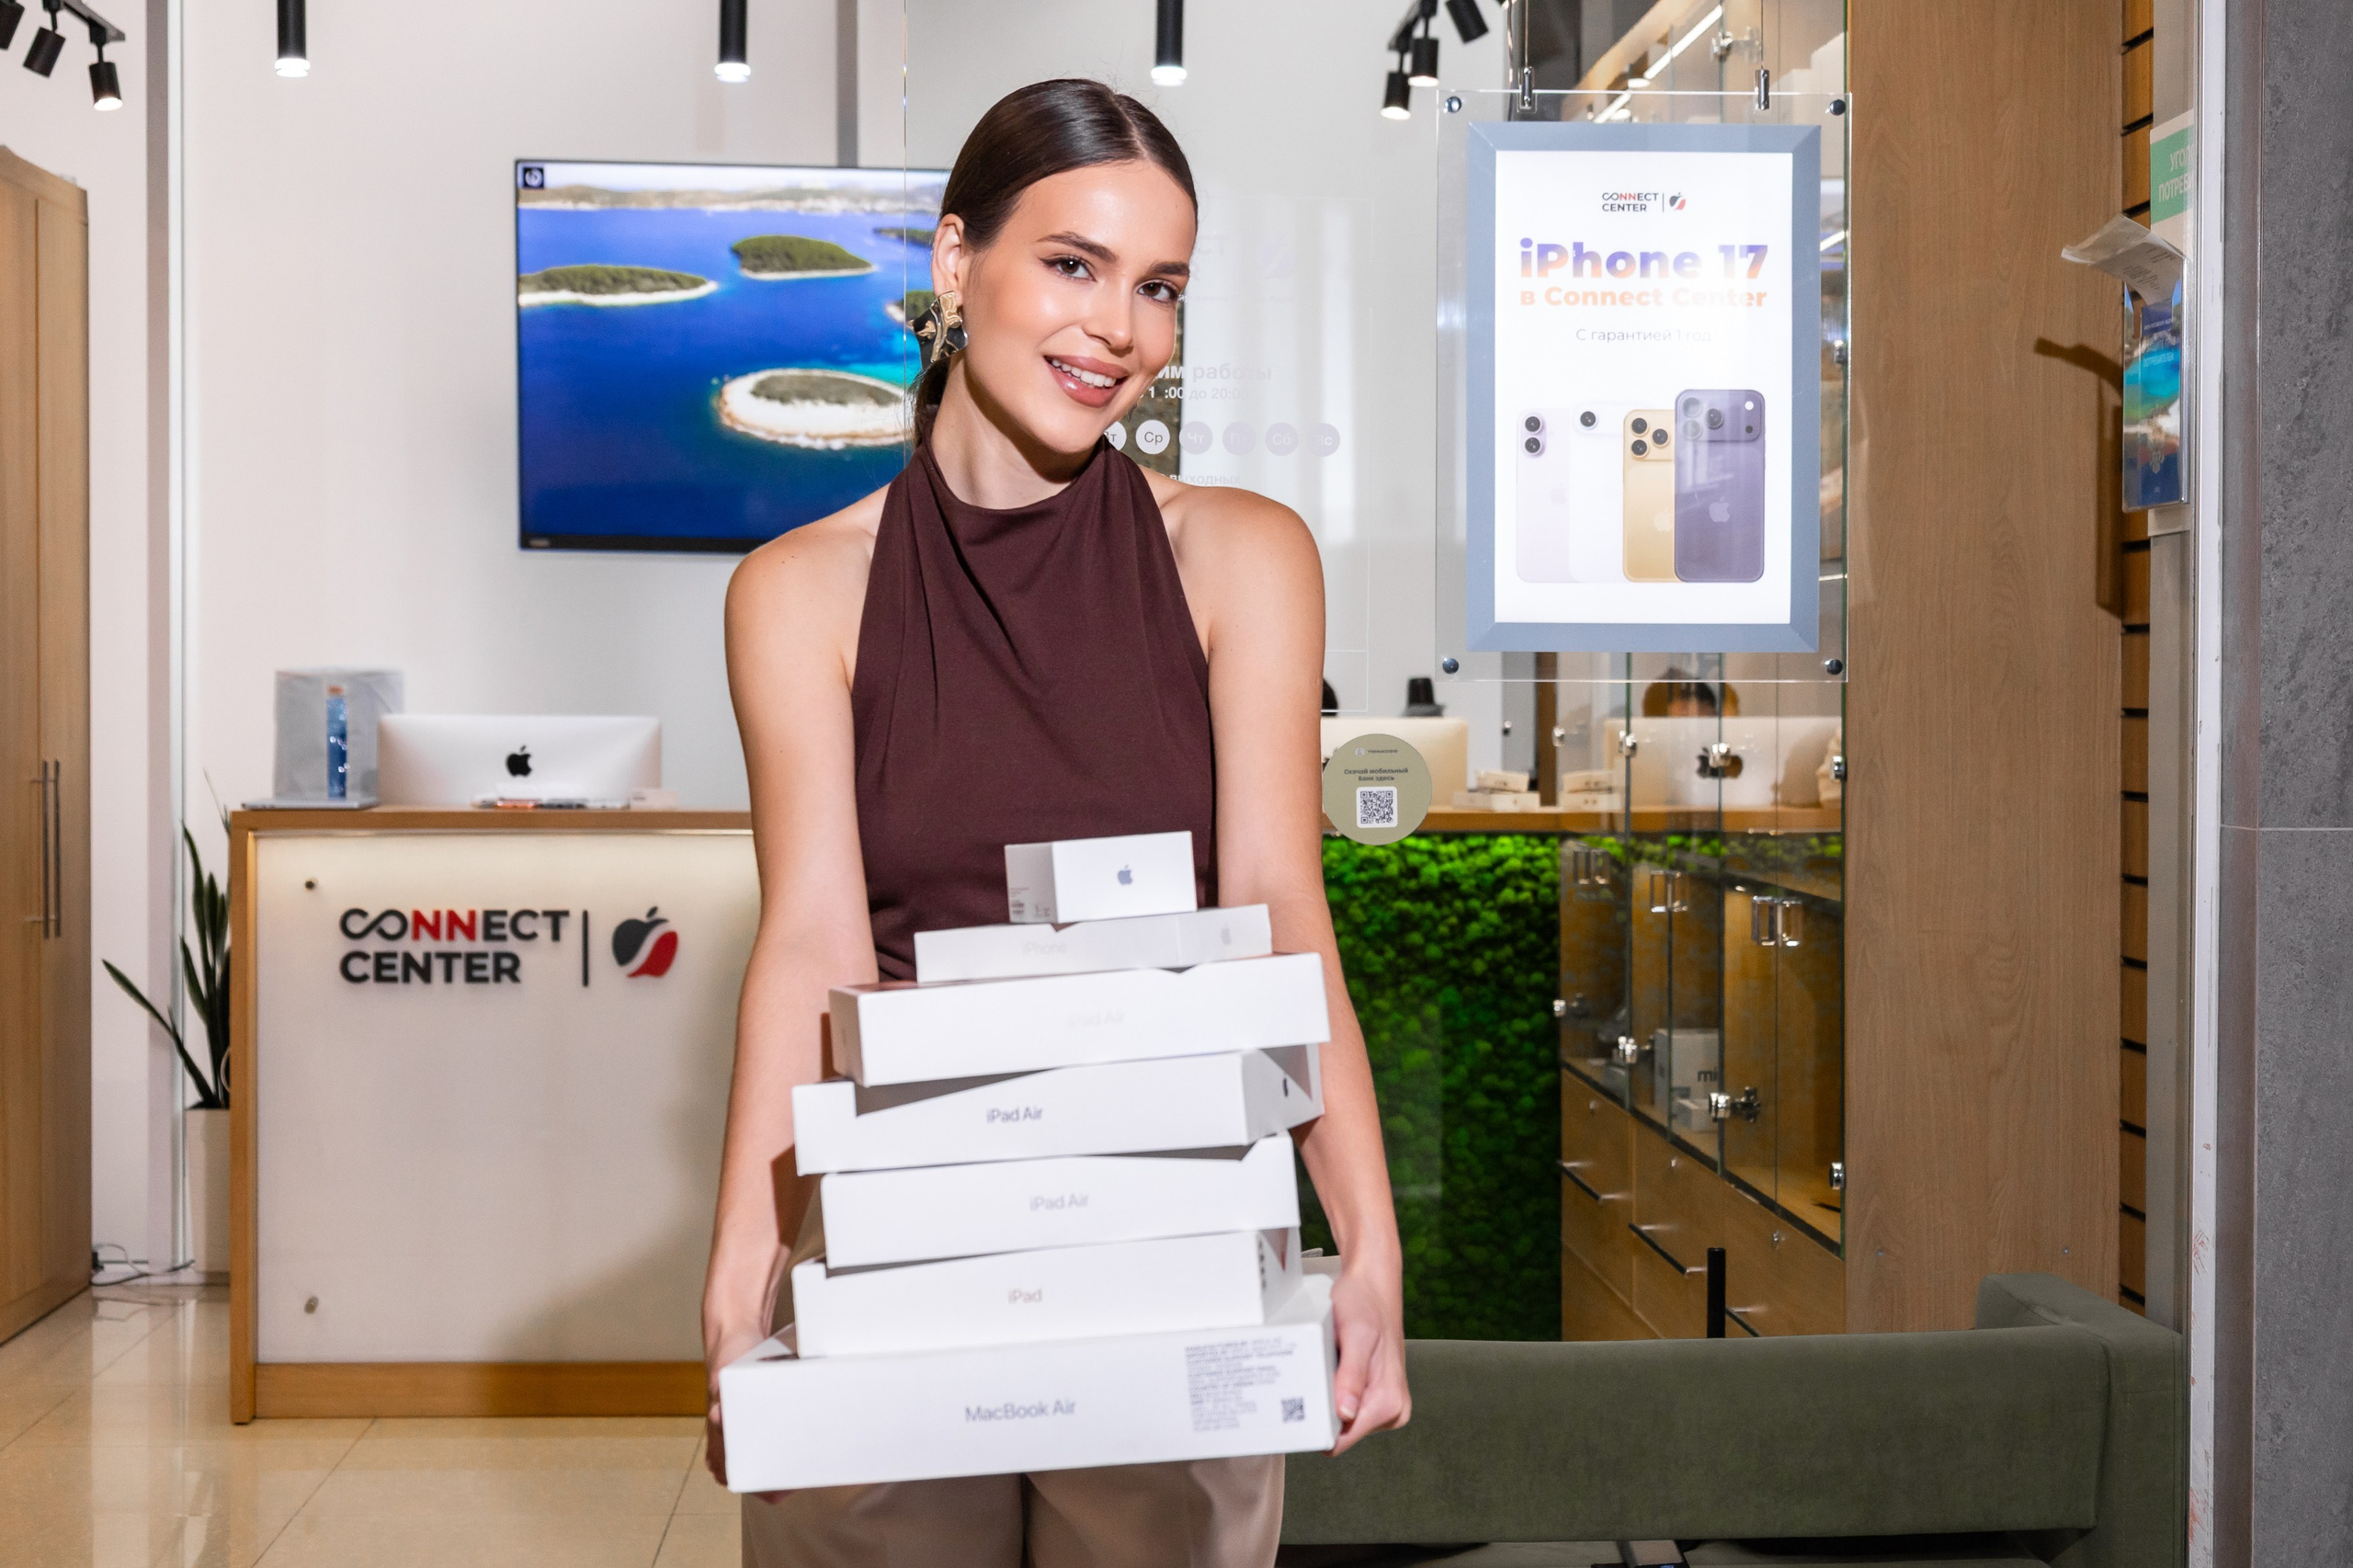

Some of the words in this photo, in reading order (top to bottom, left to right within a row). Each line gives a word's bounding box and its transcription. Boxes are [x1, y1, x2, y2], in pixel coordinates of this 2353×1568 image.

[1602, 191, 1659, 201] CONNECT
[1602, 203, 1647, 212] CENTER
[1519, 237, 1701, 279] iPhone
[1717, 244, 1768, 279] 17
[1544, 286, 1663, 307] Connect
[1672, 286, 1768, 307] Center
[1575, 328, 1586, 341] С
[1591, 328, 1671, 344] гарантией
[1192, 361, 1272, 382] работы
[1143, 431, 1164, 446] Ср
[1187, 432, 1205, 445] Чт
[1272, 433, 1291, 446] Сб
[1370, 767, 1409, 775] мобильный
[339, 907, 570, 942] CONNECT
[1022, 940, 1067, 956] iPhone
[339, 950, 521, 984] CENTER
[986, 1106, 1020, 1123] iPad
[1023, 1104, 1043, 1120] Air
[1029, 1195, 1065, 1211] iPad
[1067, 1192, 1089, 1208] Air
[1007, 1289, 1043, 1304] iPad
[964, 1402, 1049, 1422] MacBook
[1051, 1398, 1077, 1416] Air
